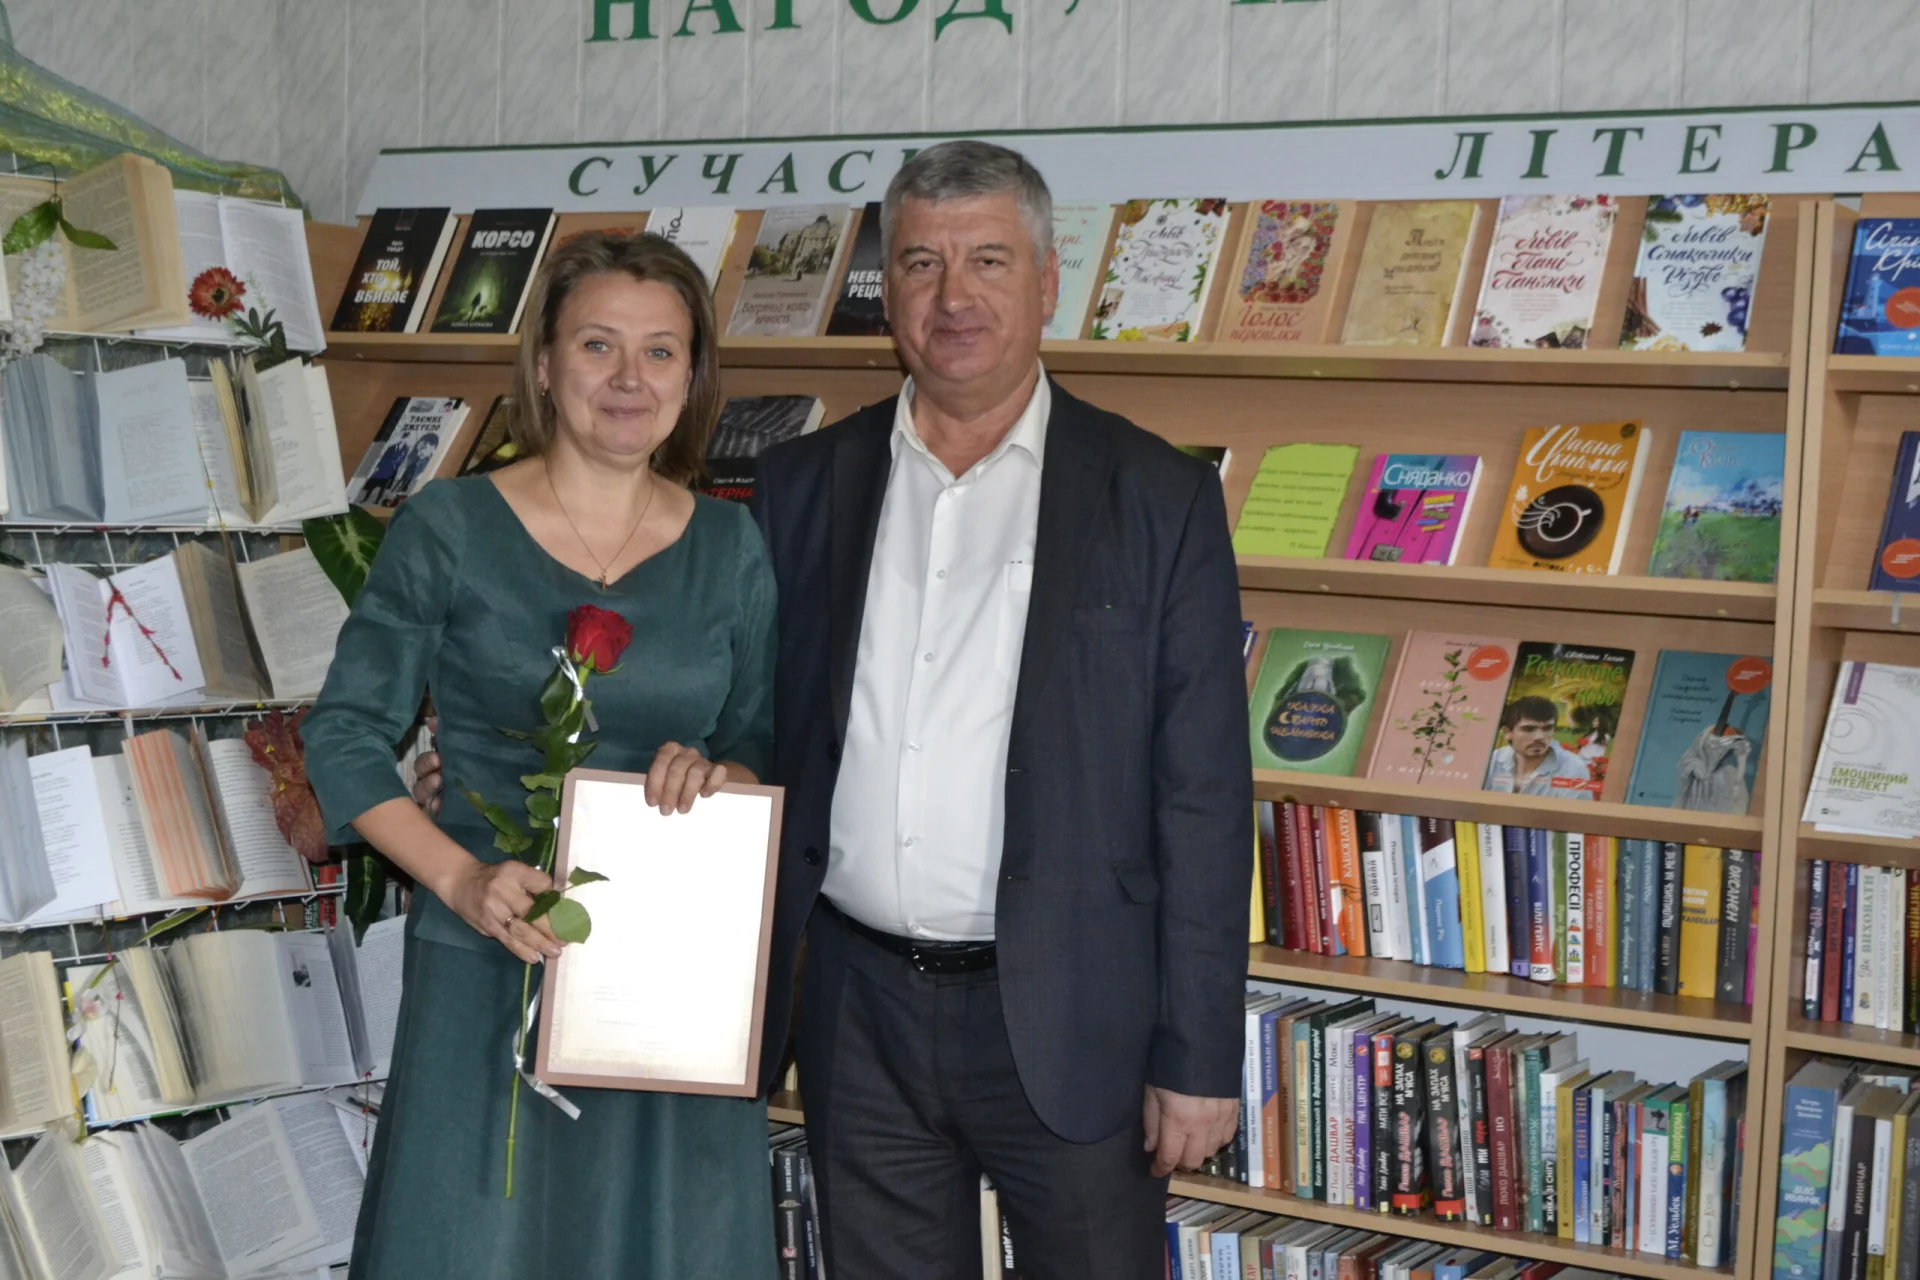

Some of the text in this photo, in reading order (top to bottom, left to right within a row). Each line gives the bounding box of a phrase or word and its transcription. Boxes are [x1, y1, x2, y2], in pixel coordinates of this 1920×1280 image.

[471, 229, 536, 249] КОРСО
[353, 290, 409, 304] ВБИВАЄ
[1383, 463, 1471, 489] Сняданко
[1828, 777, 1889, 793] ІНТЕЛЕКТ
[1830, 766, 1909, 786] ЕМОЦІЙНИЙ
[1338, 808, 1354, 879] КЛЕОПАТРА
[1568, 840, 1582, 912] ПРОФЕСІЇ
[1725, 865, 1742, 922] ОКСАНЕН
[1860, 874, 1875, 953] ВИХОВАТИ
[1329, 1041, 1338, 1068] Макс
[1394, 1063, 1404, 1105] НА ЗАПАХ
[1430, 1068, 1442, 1111] НА ЗАПАХ
[1378, 1091, 1388, 1129] МАТИ ВСЕ
[1576, 1096, 1588, 1159] СИН ТІНІ
[1329, 1116, 1341, 1164] ДАШВАР
[1344, 1117, 1354, 1165] ДАШВАР
[1398, 1111, 1412, 1192] Люко ДАШВАР
[1436, 1116, 1454, 1198] Люко ДАШВАР
[1497, 1140, 1509, 1205] ЛЮКО ДАШВАР
[1853, 1162, 1868, 1215] КРИНИЧАР
[1546, 1194, 1555, 1222] ЖІНКА
[1667, 1195, 1682, 1251] М. Уельбек
[1002, 1235, 1015, 1269] ДЕРЕШ
